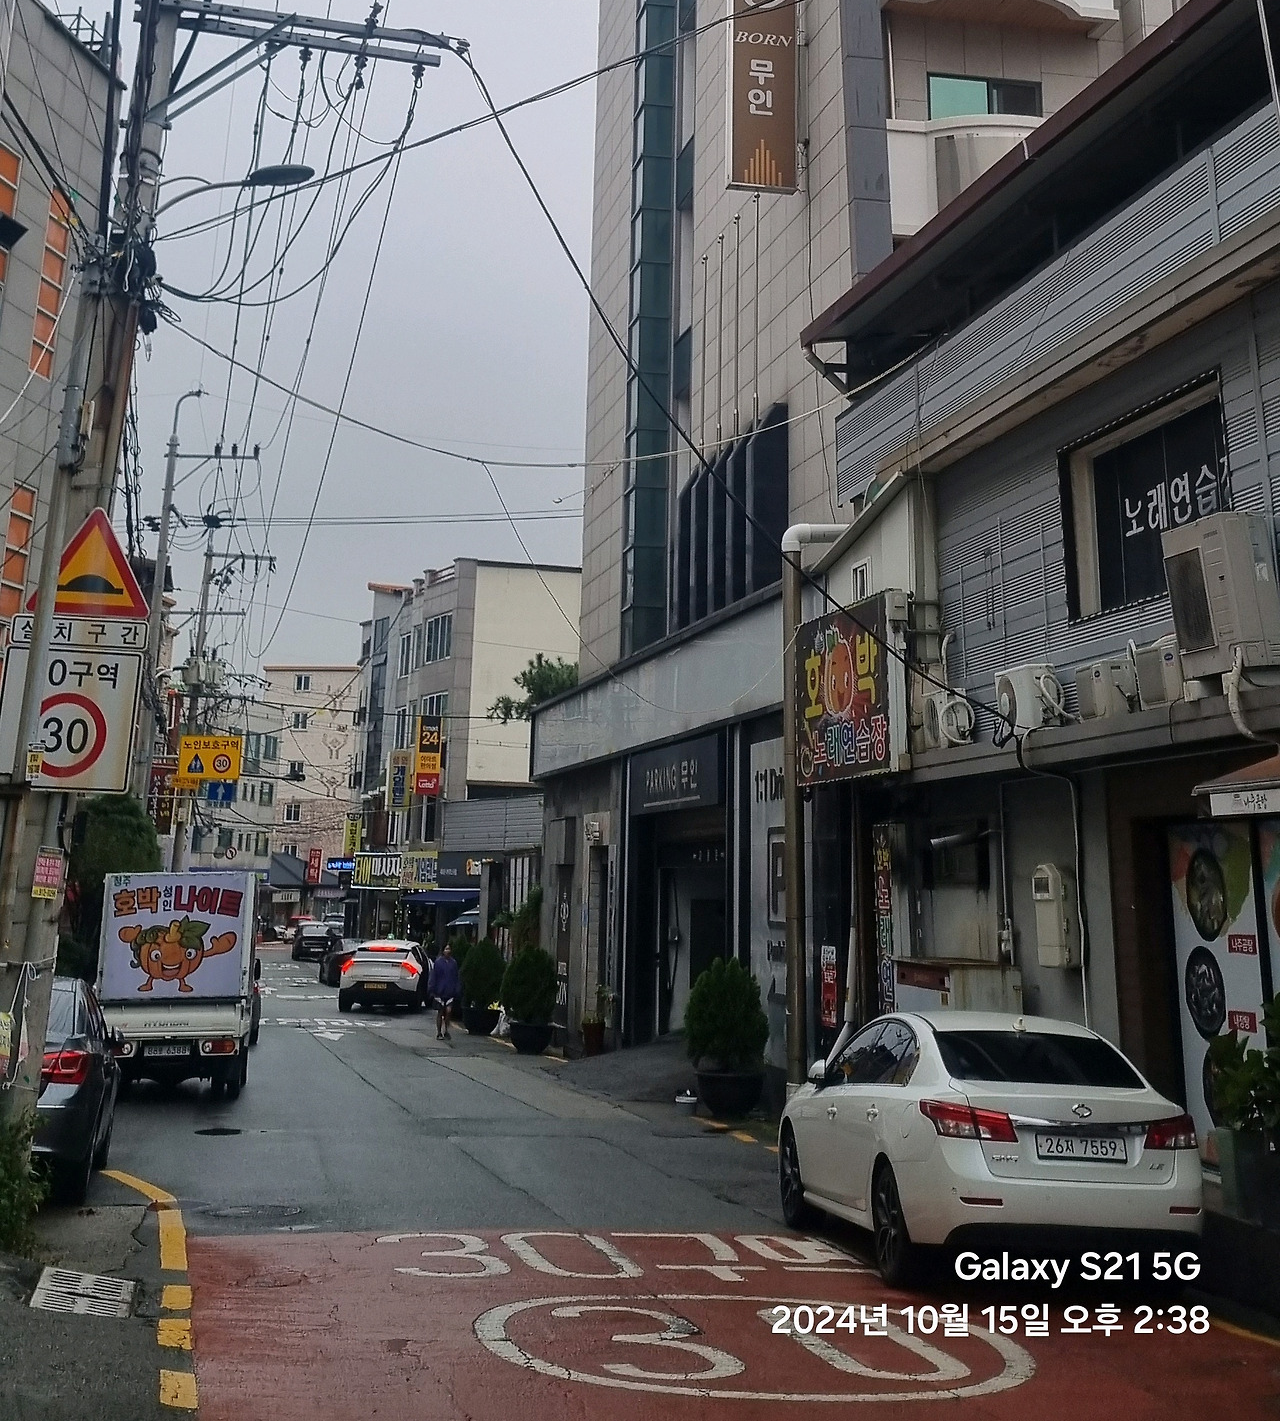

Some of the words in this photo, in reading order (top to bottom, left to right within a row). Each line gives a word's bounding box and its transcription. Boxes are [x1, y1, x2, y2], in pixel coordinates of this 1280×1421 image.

[735, 31, 792, 47] BORN
[748, 59, 775, 116] 무인
[805, 631, 878, 719] 호박
[42, 717, 89, 754] 30
[183, 739, 239, 750] 노인보호구역
[422, 732, 439, 745] 24
[813, 713, 888, 767] 노래연습장
[216, 758, 228, 768] 30
[646, 764, 677, 793] PARKING
[681, 760, 698, 789] 무인
[755, 769, 768, 803] 1:1
[770, 767, 785, 801] Dri
[354, 857, 372, 884] 타이
[372, 857, 400, 877] 마사지
[113, 887, 161, 917] 호박
[162, 885, 173, 912] 성인
[174, 885, 244, 917] 나이트
[1232, 938, 1253, 953] 나주곰탕
[1045, 1138, 1074, 1155] 26저
[1079, 1139, 1117, 1157] 7559
